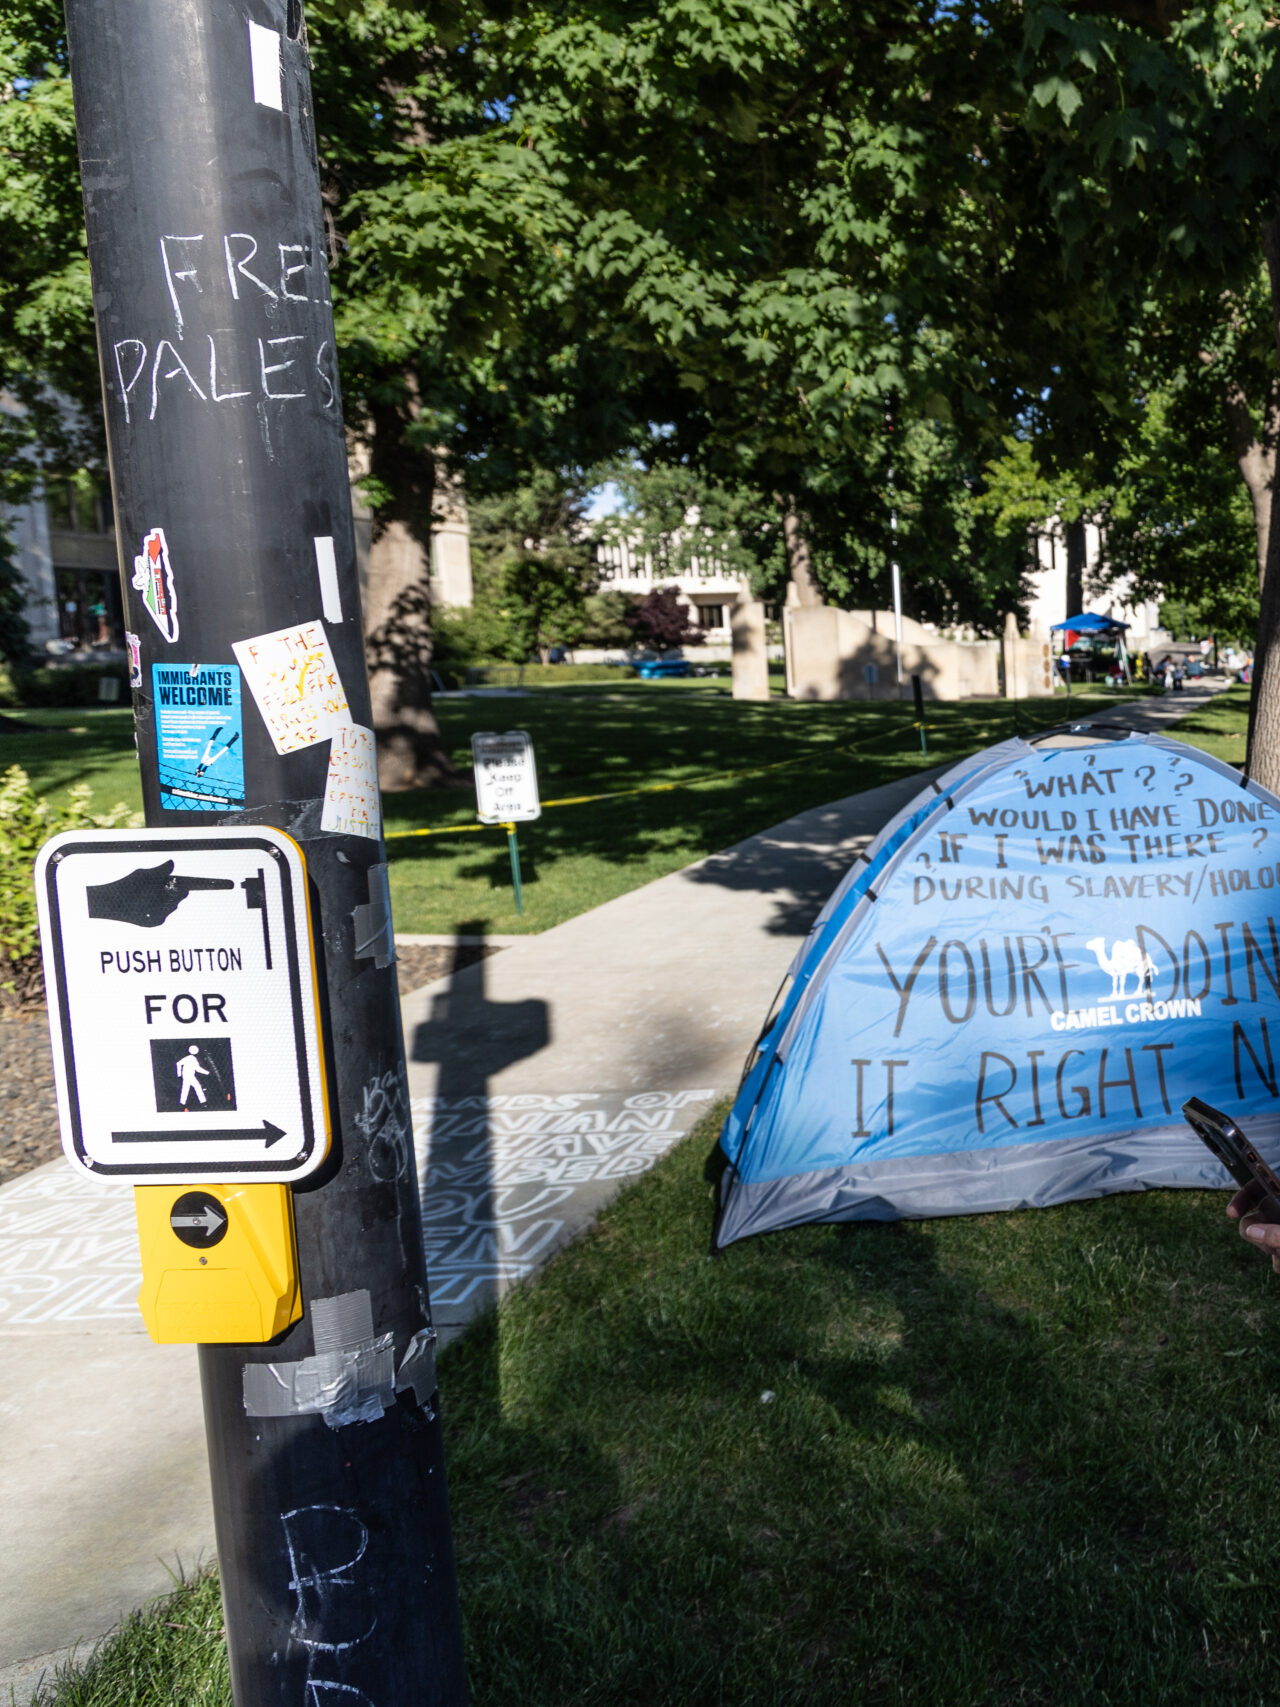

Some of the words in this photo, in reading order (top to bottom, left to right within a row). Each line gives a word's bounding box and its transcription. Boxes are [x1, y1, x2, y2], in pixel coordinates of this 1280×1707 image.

[158, 671, 231, 686] IMMIGRANTS
[159, 686, 232, 706] WELCOME
[968, 807, 1078, 832] WOULD
[1087, 808, 1102, 832] I
[1110, 804, 1182, 832] HAVE
[1194, 797, 1275, 829] DONE
[938, 831, 968, 864] IF
[995, 833, 1008, 869] I
[1035, 833, 1106, 865] WAS
[1120, 830, 1228, 864] THERE
[913, 875, 1050, 905] DURING
[100, 950, 162, 974] PUSH
[169, 947, 242, 972] BUTTON
[144, 993, 229, 1024] FOR
[1050, 1005, 1123, 1032] CAMEL
[1125, 997, 1202, 1024] CROWN
[851, 1058, 910, 1138] IT
[975, 1042, 1175, 1134] RIGHT
